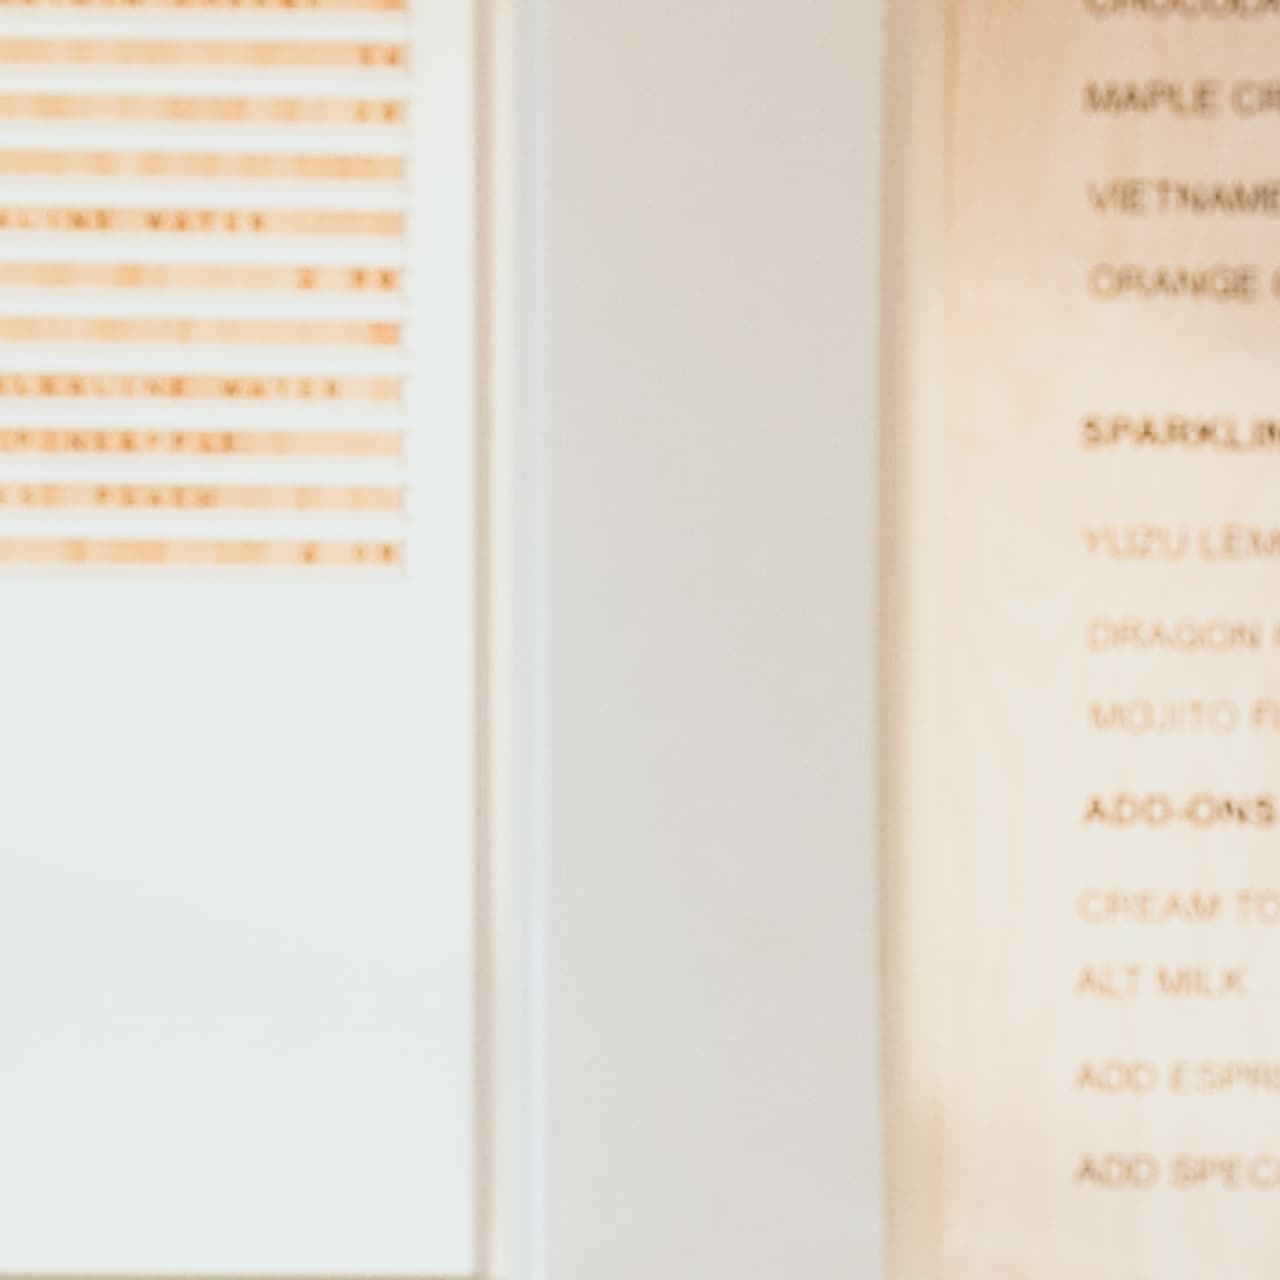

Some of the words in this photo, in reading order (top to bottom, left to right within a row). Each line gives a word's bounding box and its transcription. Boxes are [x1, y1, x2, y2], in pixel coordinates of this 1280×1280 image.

[1086, 79, 1215, 116] MAPLE
[1087, 263, 1259, 300] ORANGE
[1081, 526, 1186, 559] YUZU
[1086, 618, 1259, 653] DRAGON
[1091, 700, 1241, 734] MOJITO
[1084, 793, 1278, 827] ADD-ONS
[1077, 890, 1221, 924] CREAM
[1076, 965, 1144, 996] ALT
[1155, 965, 1248, 996] MILK
[1076, 1062, 1157, 1096] ADD
[1076, 1154, 1157, 1190] ADD
